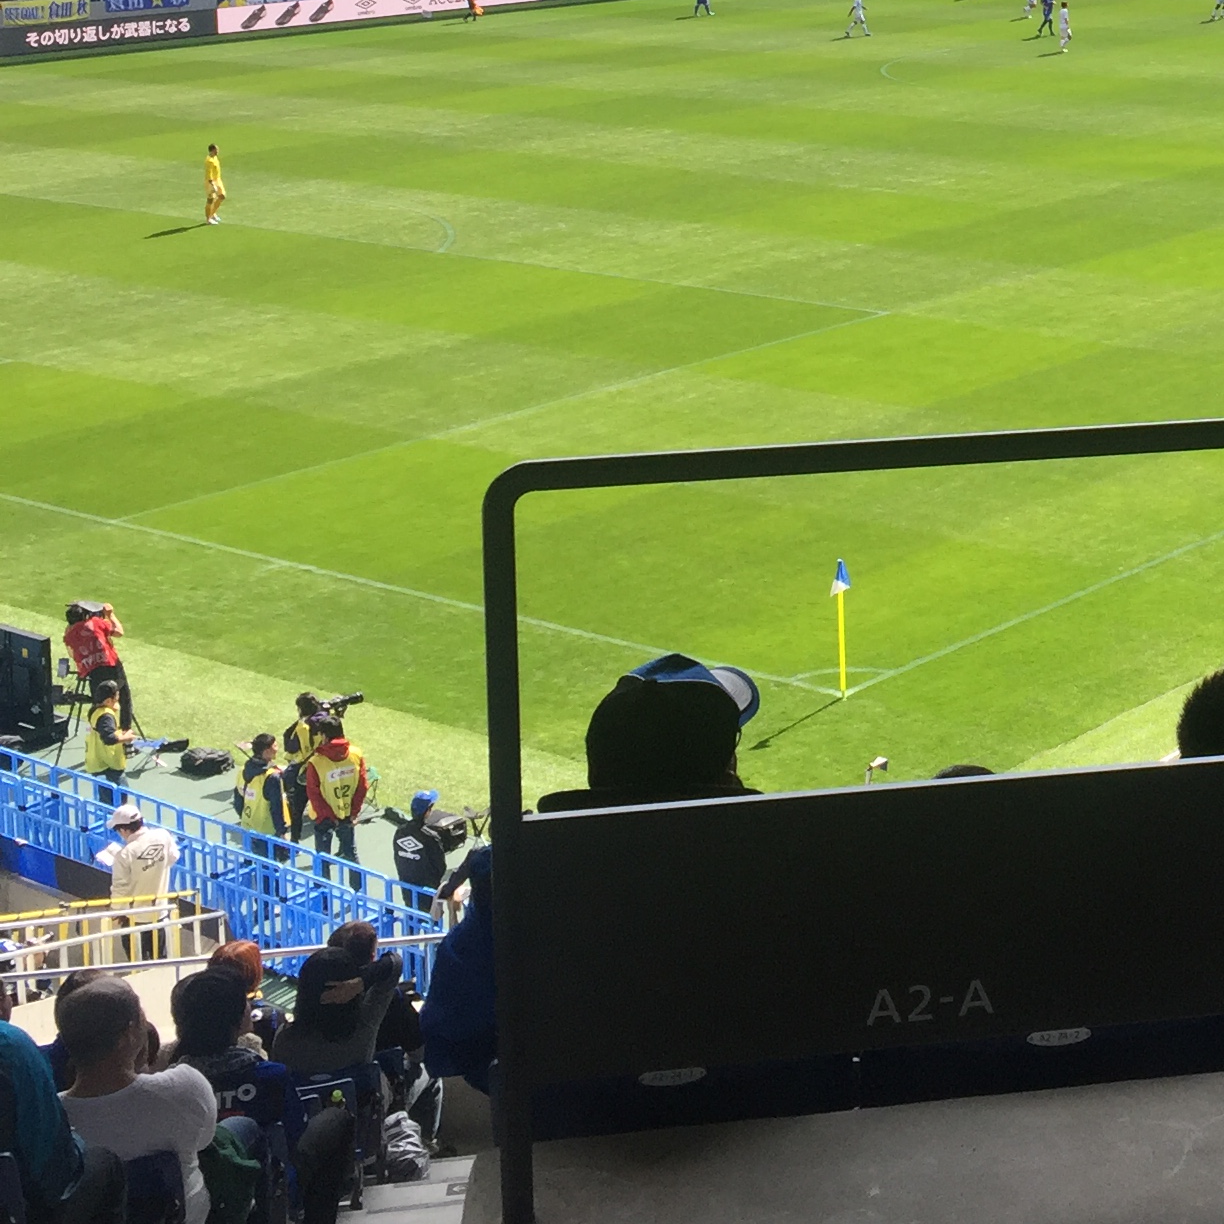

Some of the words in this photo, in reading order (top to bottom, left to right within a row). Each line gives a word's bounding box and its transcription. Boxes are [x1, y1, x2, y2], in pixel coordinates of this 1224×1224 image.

[25, 17, 191, 47] その切り返しが武器になる
[866, 978, 995, 1026] A2-A
